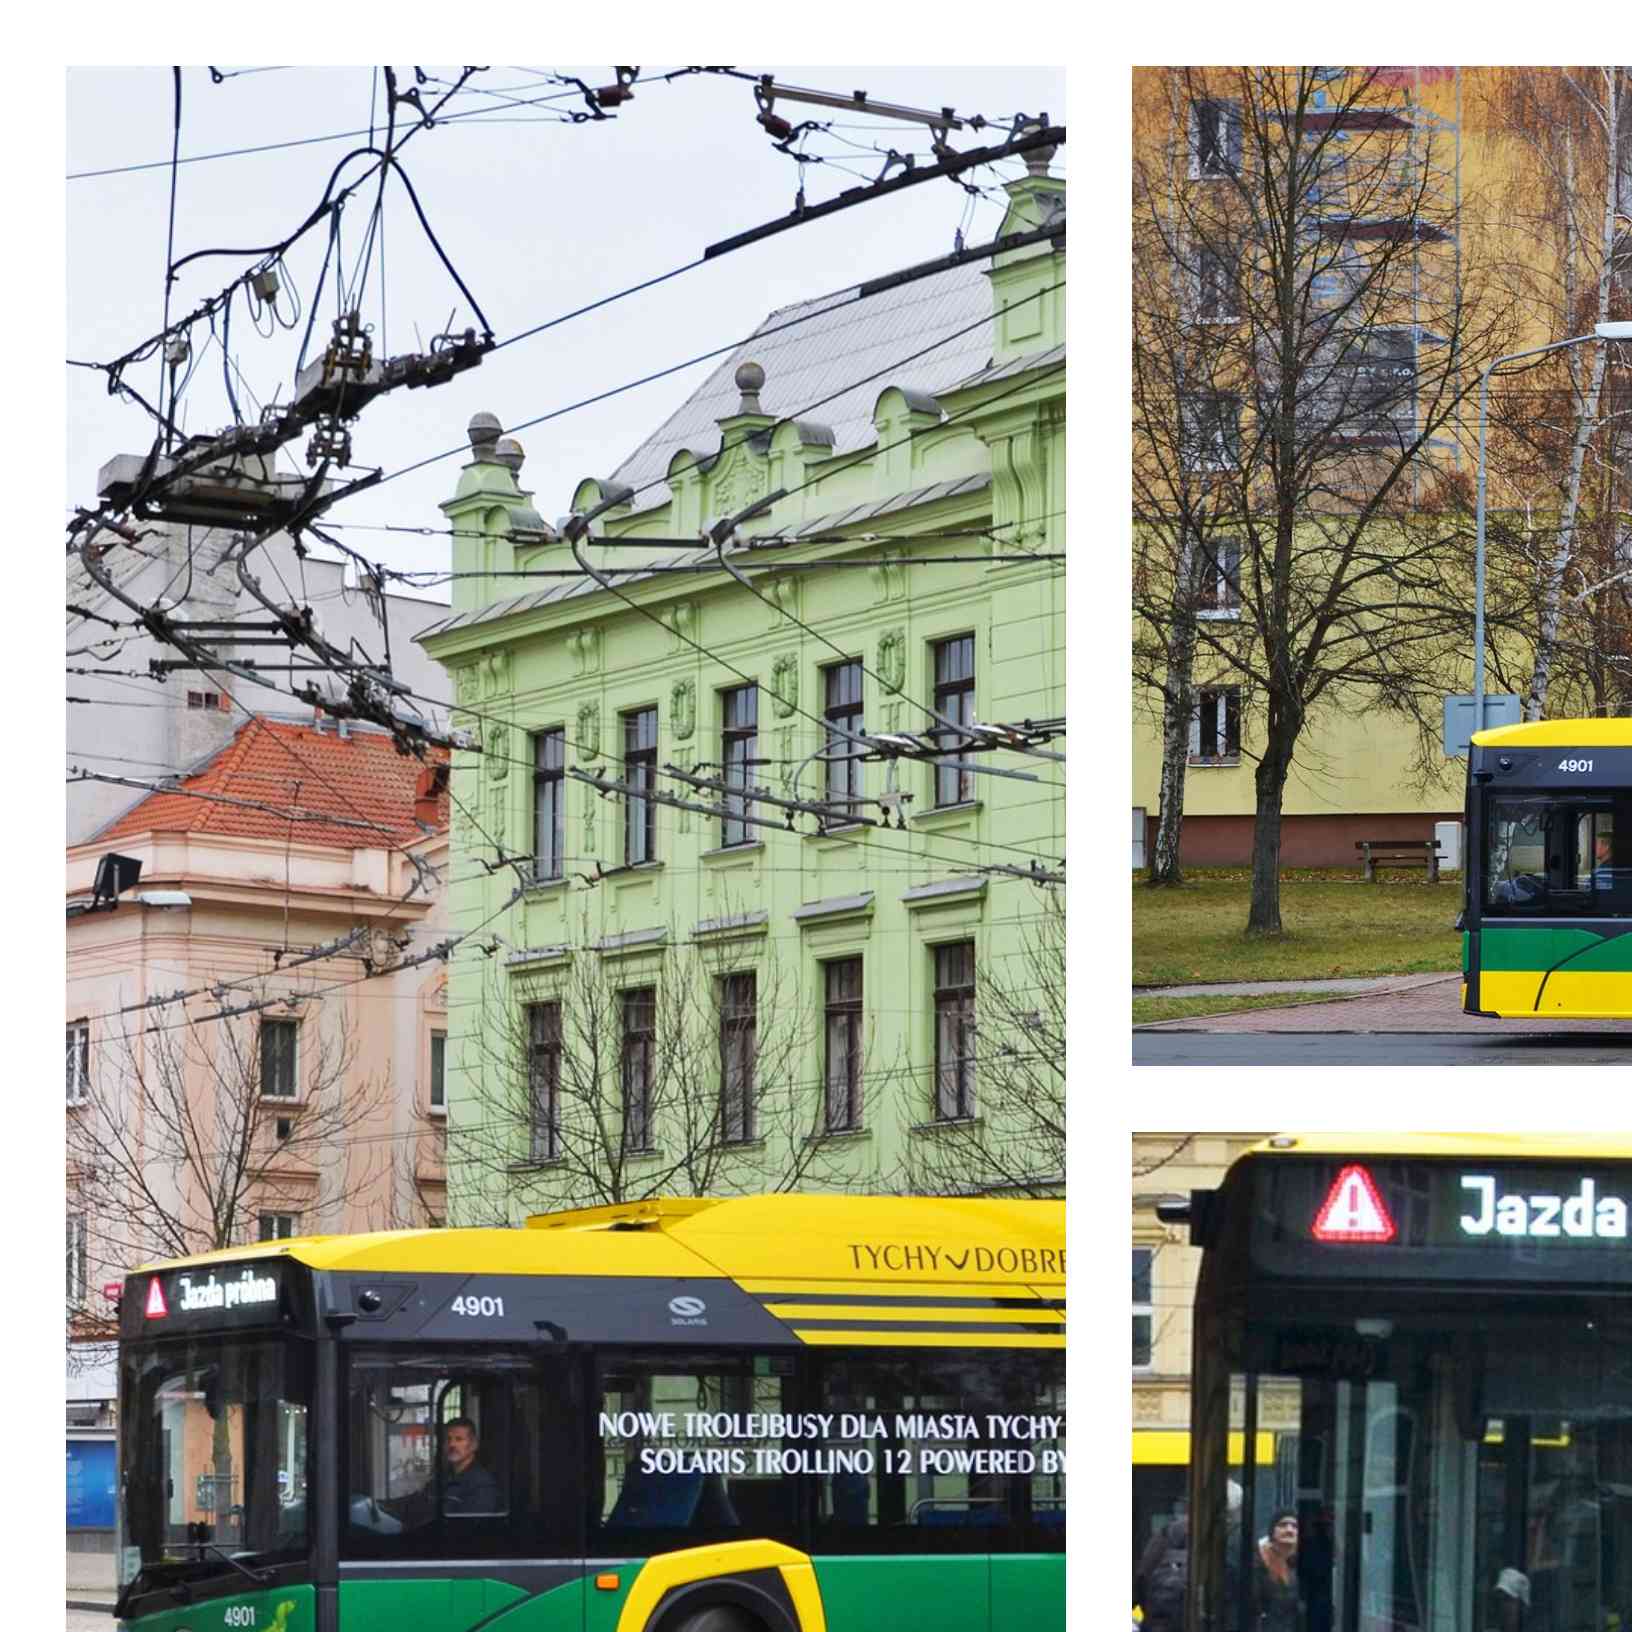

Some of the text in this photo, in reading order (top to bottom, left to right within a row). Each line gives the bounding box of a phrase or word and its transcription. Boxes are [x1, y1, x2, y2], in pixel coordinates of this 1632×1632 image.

[1558, 759, 1593, 773] 4901
[1460, 1175, 1627, 1238] Jazda
[847, 1243, 942, 1271] TYCHY
[179, 1269, 276, 1311] Jazda próbna
[451, 1296, 504, 1317] 4901
[599, 1412, 1062, 1440] NOWE TROLEJBUSY DLA MIASTA TYCHY
[641, 1449, 746, 1475] SOLARIS
[754, 1449, 874, 1475] TROLLINO
[884, 1449, 912, 1475] 12
[920, 1450, 1035, 1475] POWERED
[224, 1606, 256, 1627] 4901
